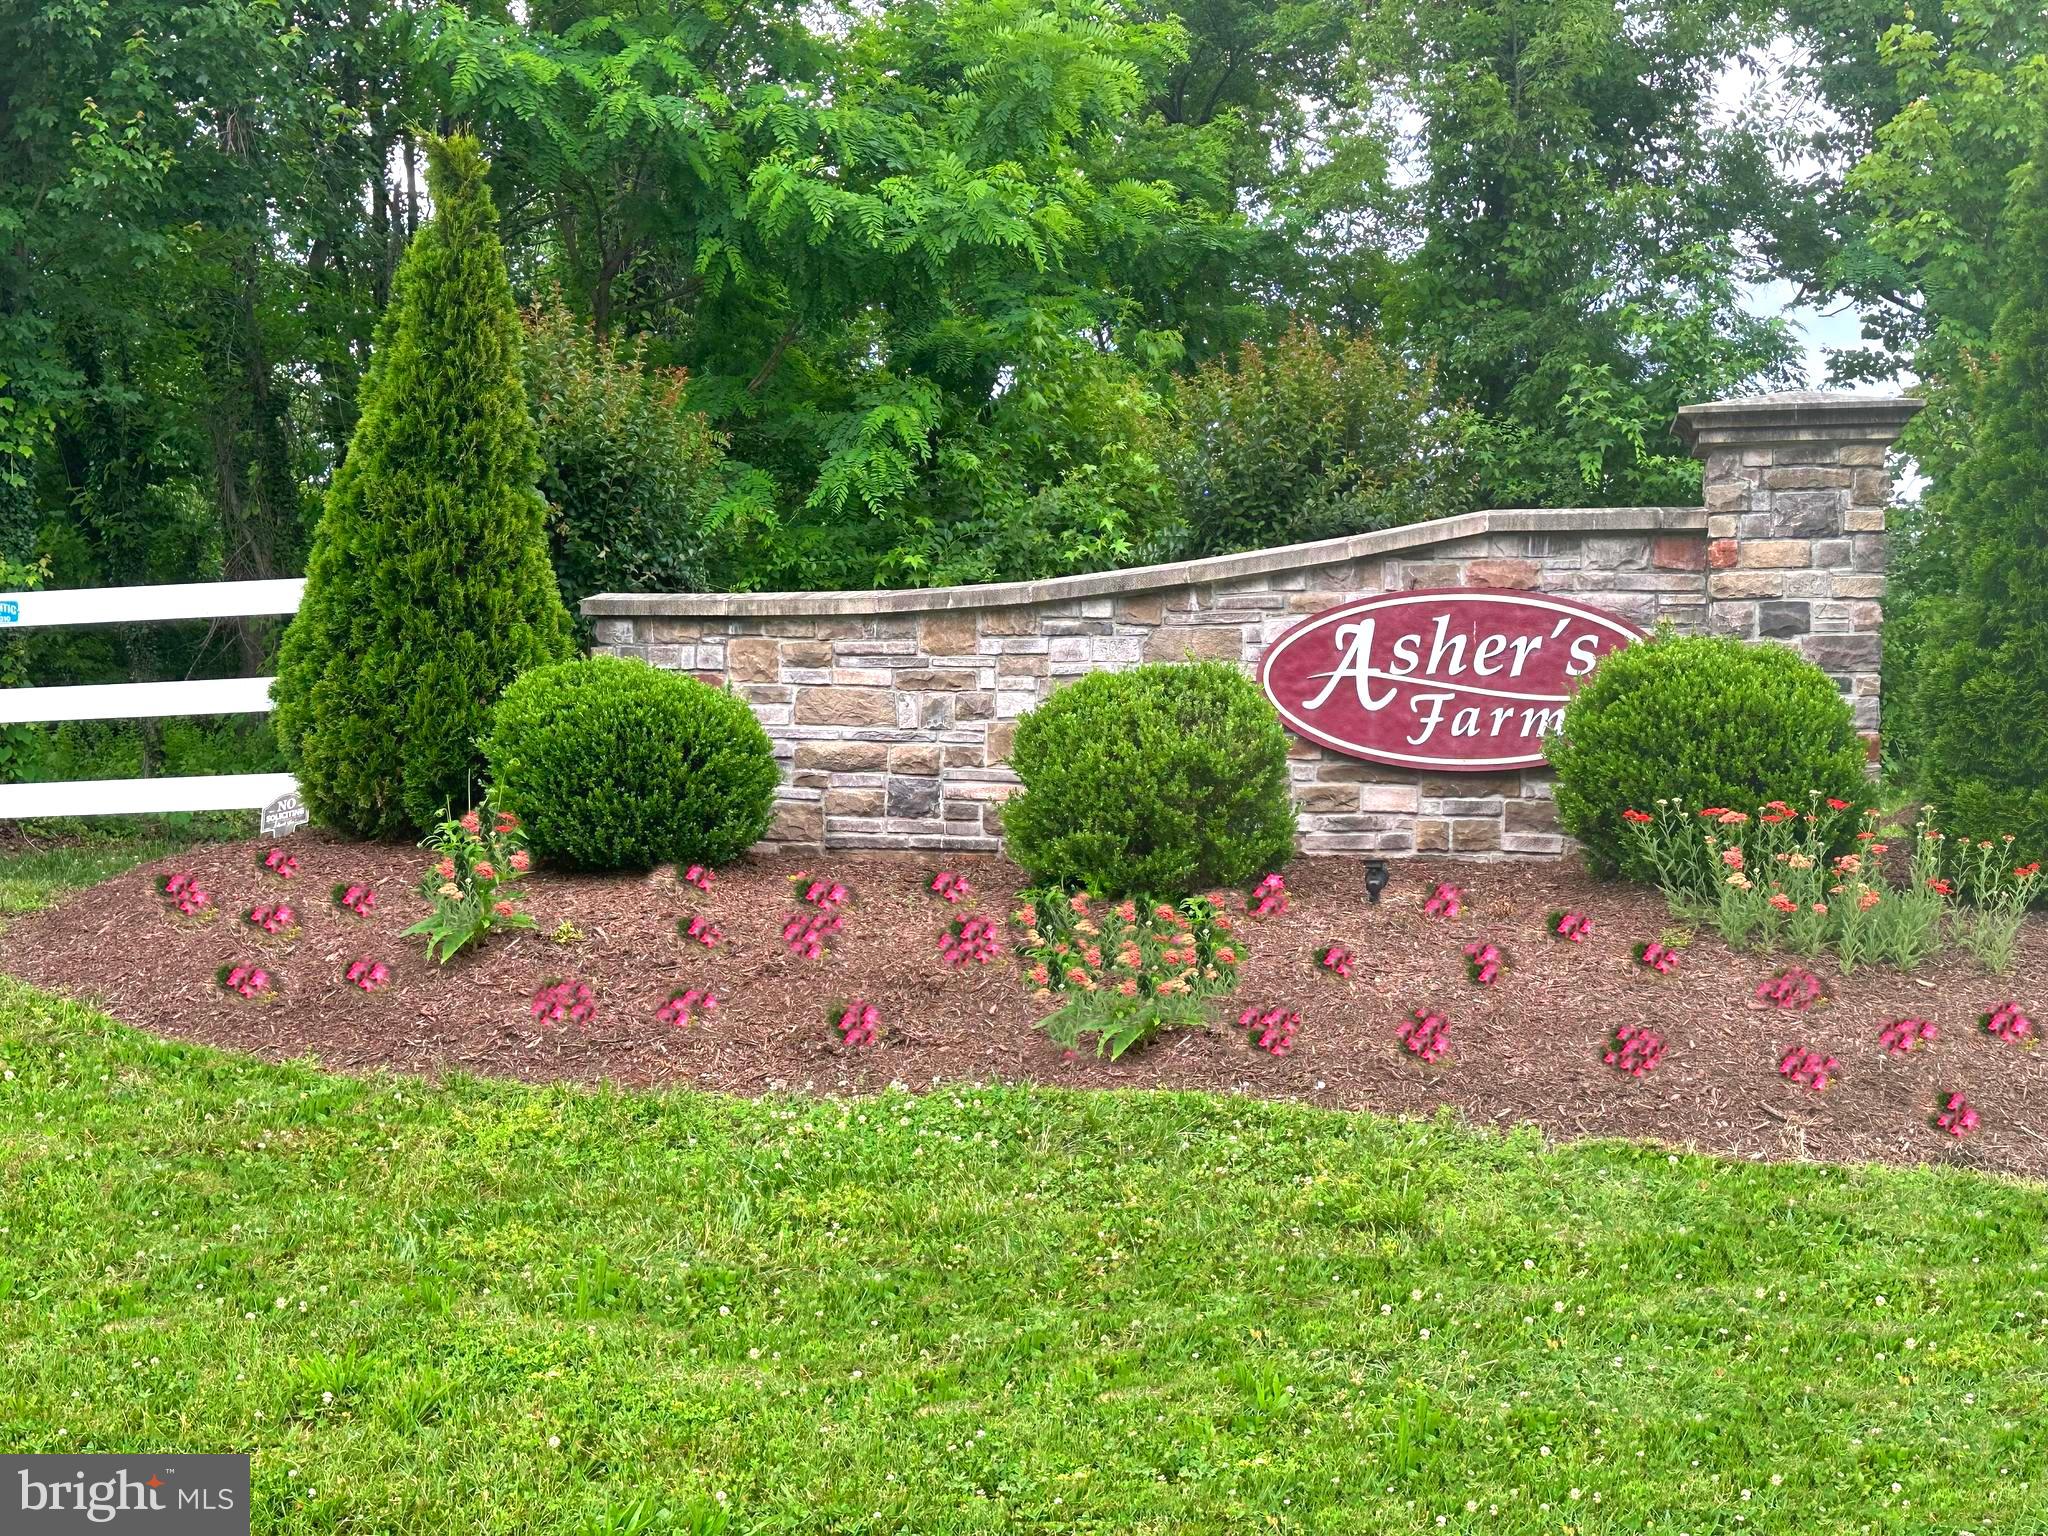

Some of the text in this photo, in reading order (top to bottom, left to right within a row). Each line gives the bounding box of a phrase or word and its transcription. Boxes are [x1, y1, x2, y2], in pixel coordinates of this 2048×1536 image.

[1302, 613, 1599, 711] Asher's
[277, 798, 296, 812] NO
[266, 807, 304, 822] SOLICITING
